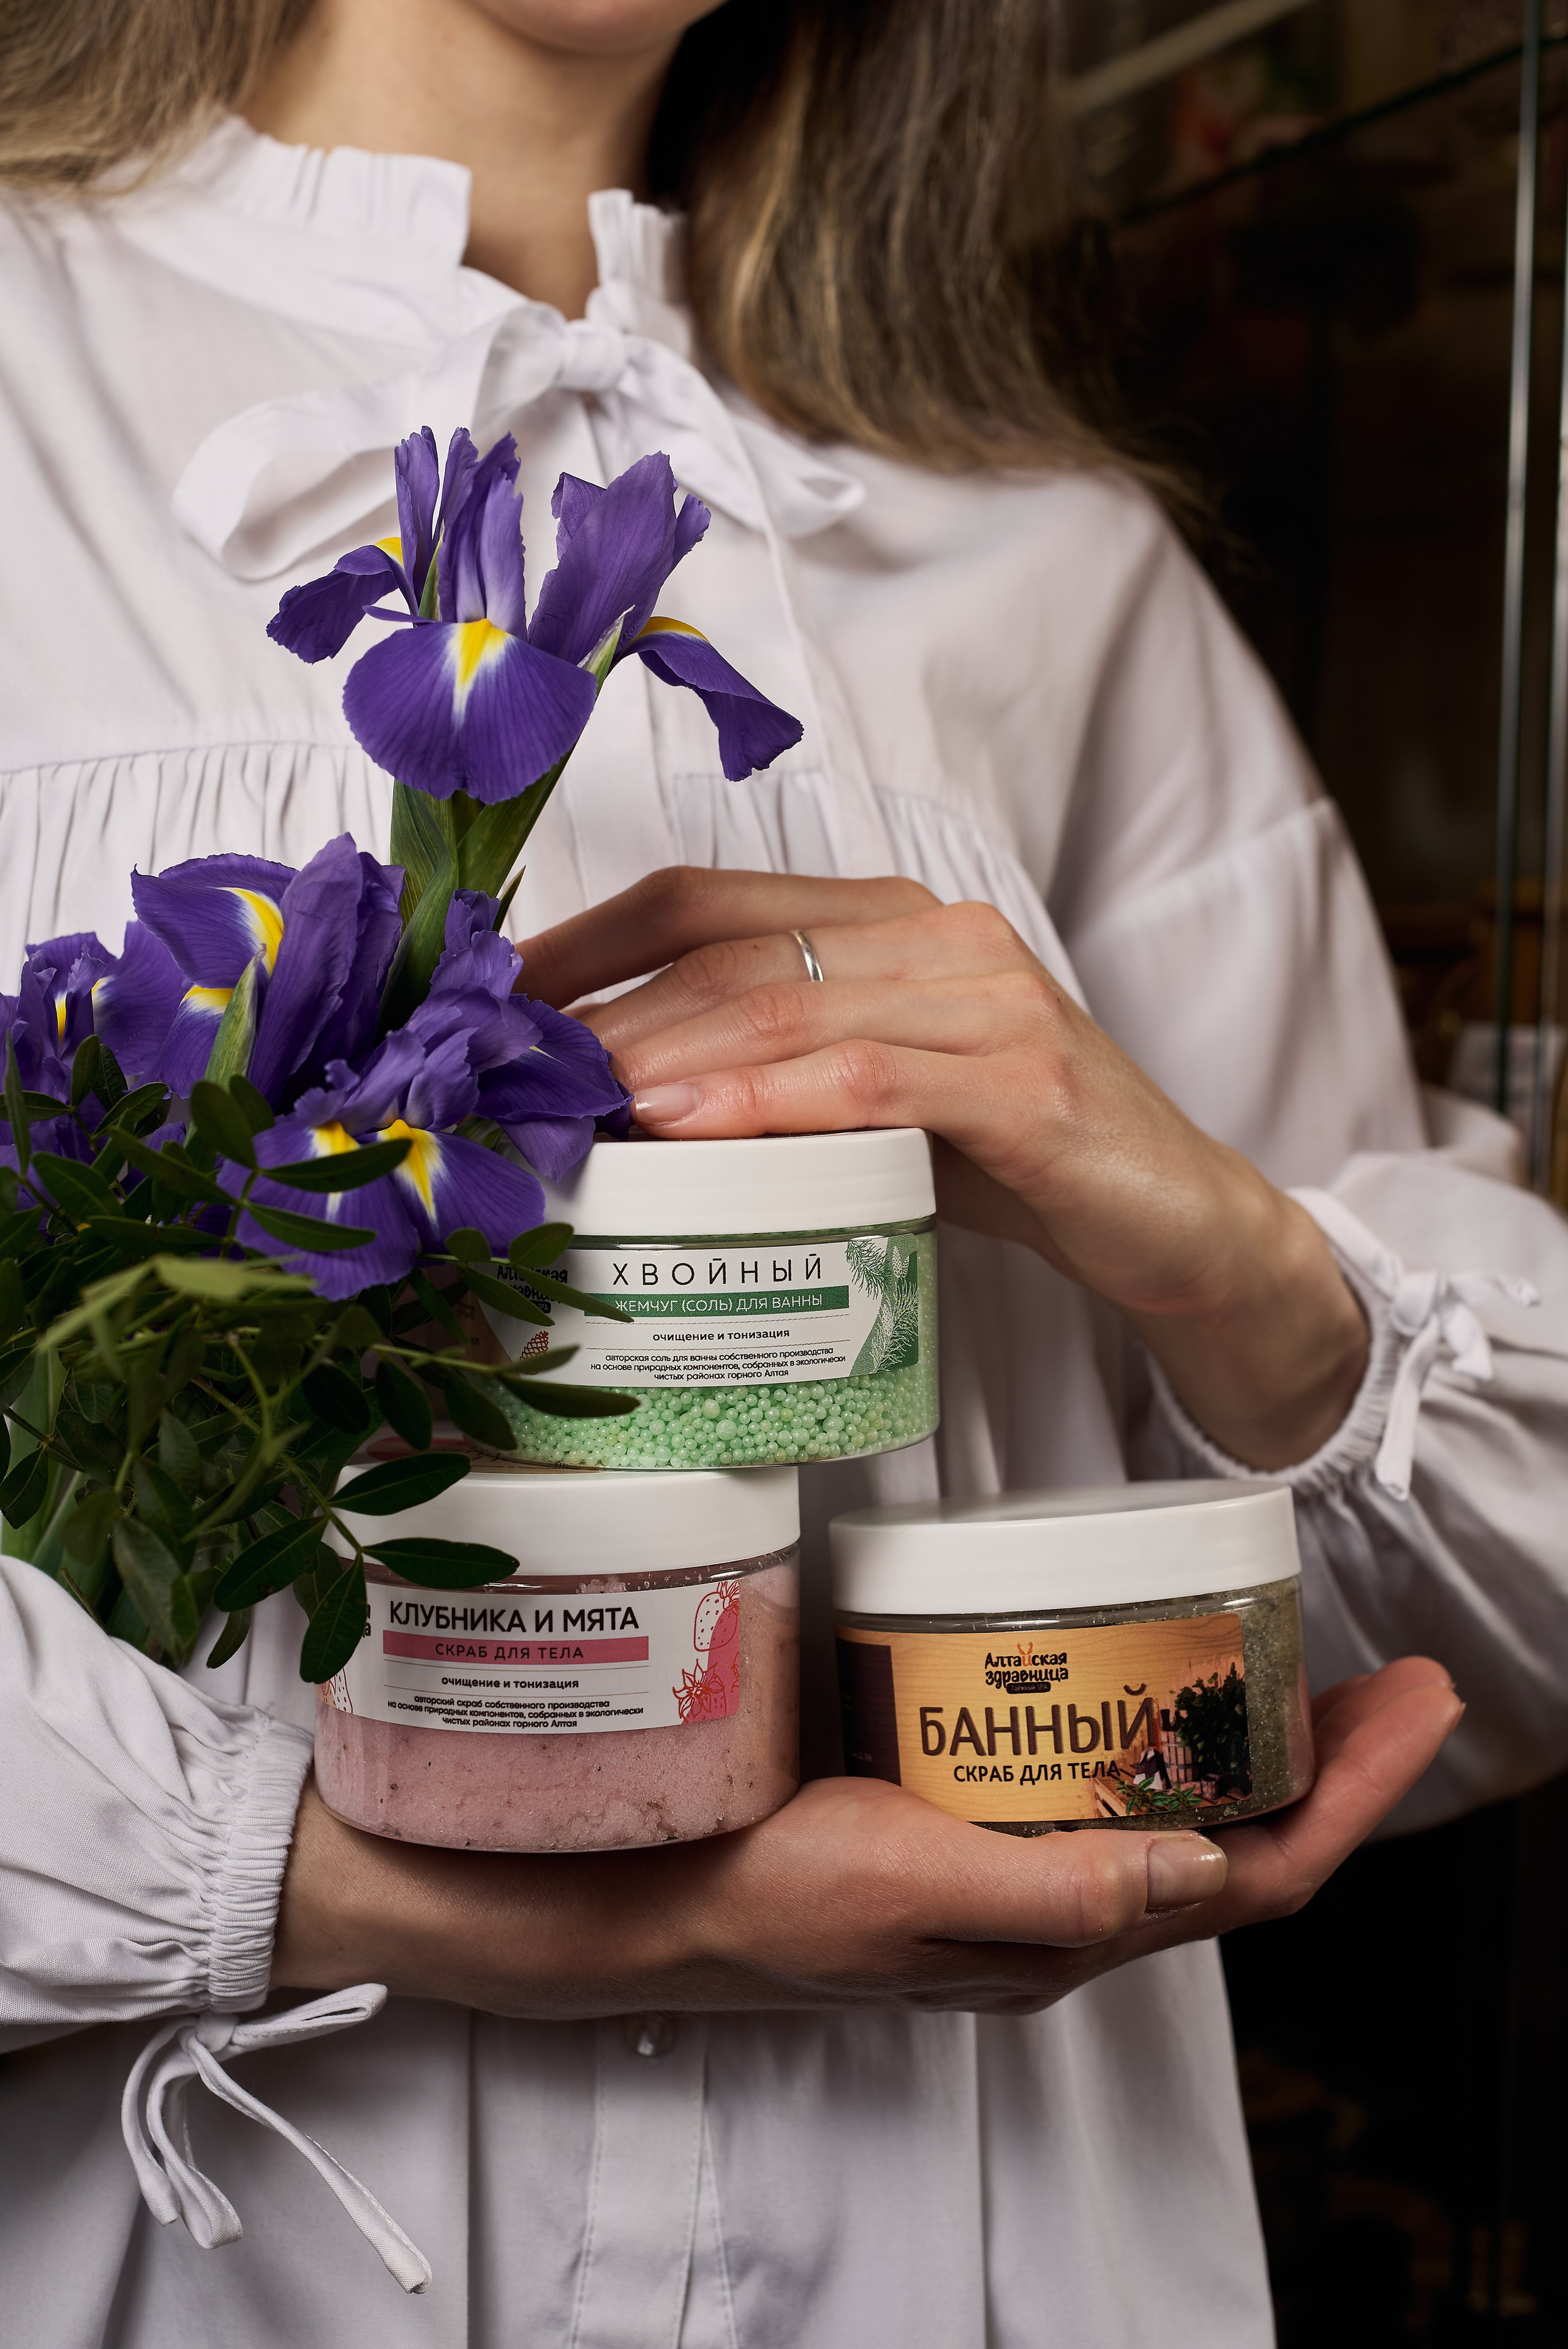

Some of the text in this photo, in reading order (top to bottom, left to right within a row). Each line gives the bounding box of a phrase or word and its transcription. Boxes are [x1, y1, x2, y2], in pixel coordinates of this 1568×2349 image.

[612, 1253, 821, 1286] ХВОЙНЫЙ
[614, 1294, 823, 1312] ЖЕМЧУГ (СОЛЬ) ДЛЯ ВАННЫ
[652, 1333, 715, 1342] очищение
[727, 1330, 790, 1340] тонизация
[605, 1354, 649, 1363] авторская
[719, 1352, 778, 1361] собственного
[779, 1348, 834, 1359] производства
[742, 1360, 788, 1371] собранных
[796, 1355, 846, 1366] экологически
[686, 1372, 725, 1381] районах
[727, 1371, 763, 1380] горного
[764, 1369, 789, 1378] Алтая
[390, 1601, 527, 1632] КЛУБНИКА
[535, 1610, 553, 1632] И
[563, 1606, 639, 1632] МЯТА
[435, 1643, 584, 1661] СКРАБ ДЛЯ ТЕЛА
[985, 1642, 1067, 1669] Алтайская
[442, 1677, 500, 1687] очищение
[513, 1680, 579, 1689] тонизация
[986, 1667, 1069, 1689] здравница
[398, 1703, 423, 1712] основе
[424, 1706, 468, 1716] природных
[469, 1710, 526, 1719] компонентов,
[527, 1710, 577, 1720] собранных
[586, 1707, 644, 1717] экологически
[414, 1695, 610, 1711] авторский скраб собственного производства
[442, 1716, 470, 1725] чистых
[472, 1718, 511, 1727] районах
[513, 1721, 549, 1729] горного
[919, 1683, 1156, 1757] БАННЫЙ
[953, 1760, 1121, 1786] СКРАБ ДЛЯ ТЕЛА
